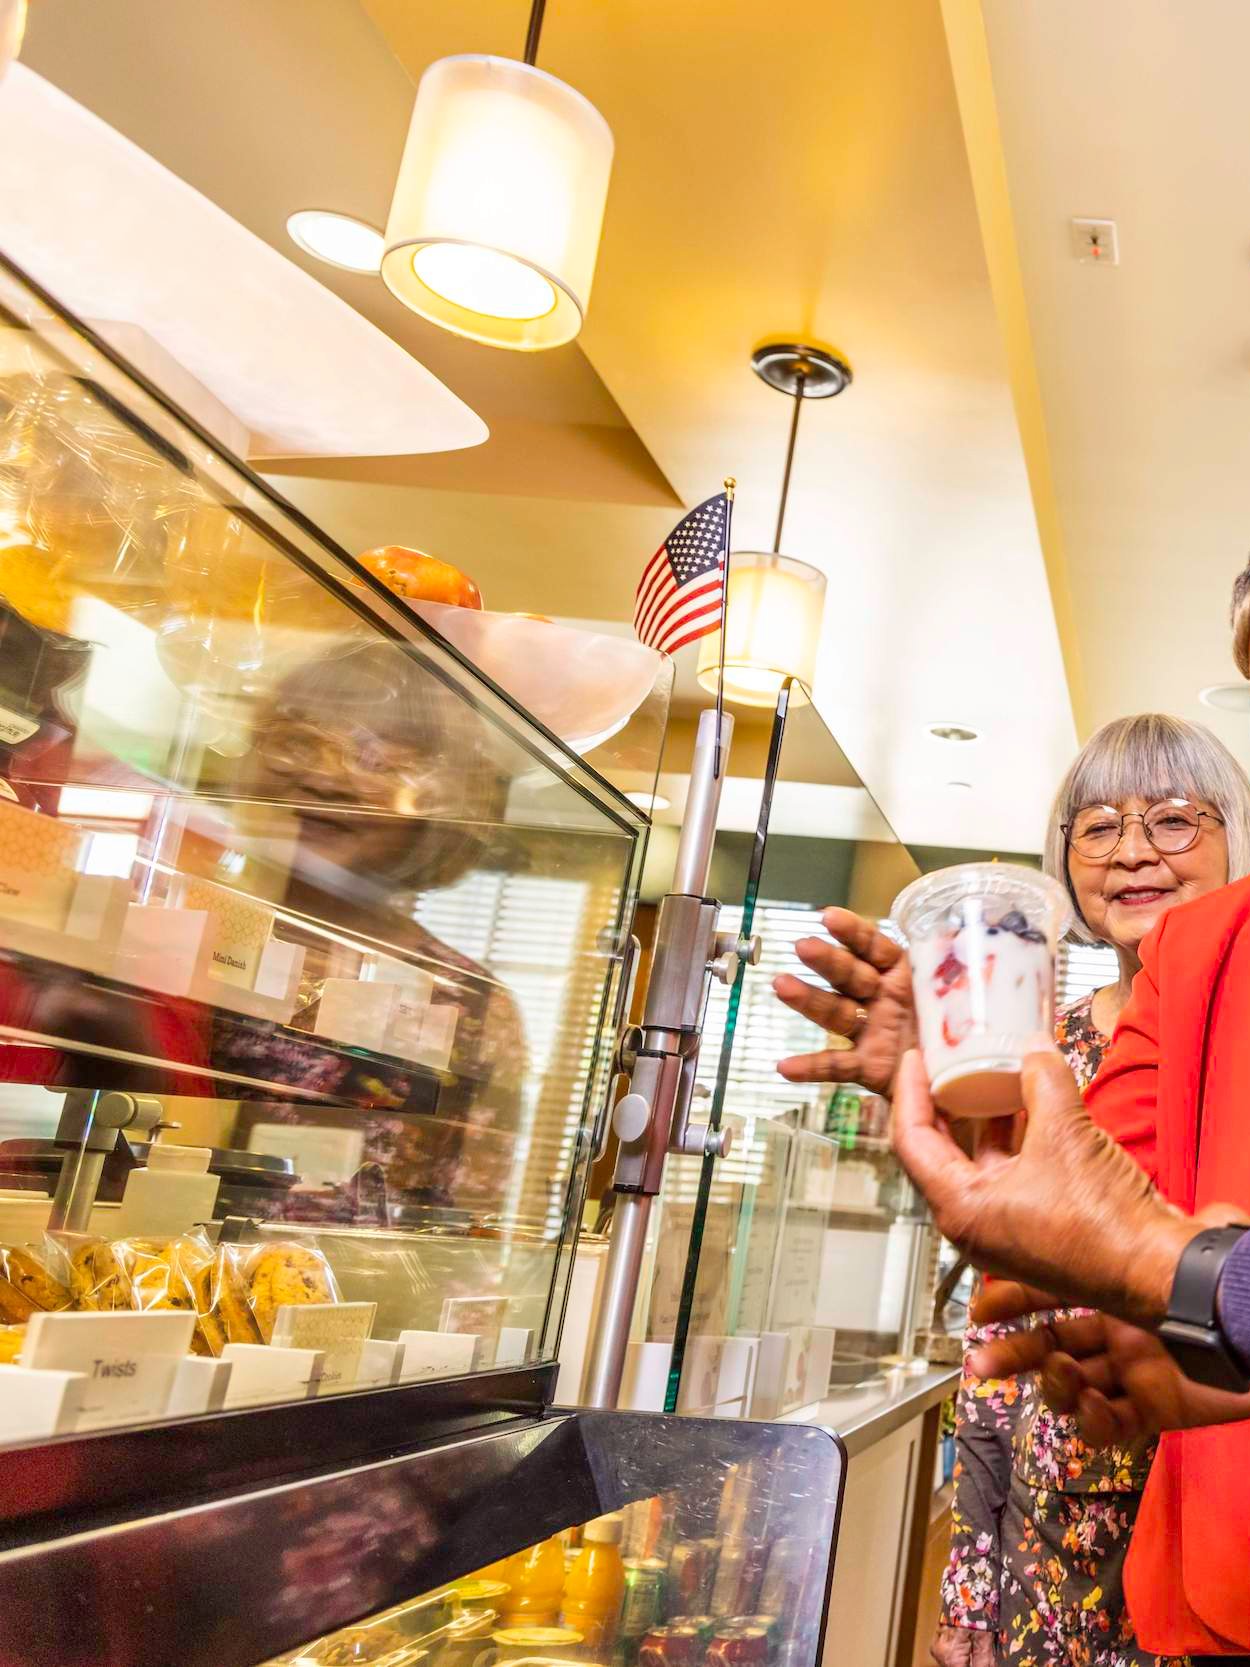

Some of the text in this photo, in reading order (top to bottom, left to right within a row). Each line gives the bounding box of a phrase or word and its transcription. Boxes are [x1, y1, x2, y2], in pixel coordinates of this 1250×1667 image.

[212, 951, 246, 970] Mini Danish
[93, 1359, 137, 1379] Twists
